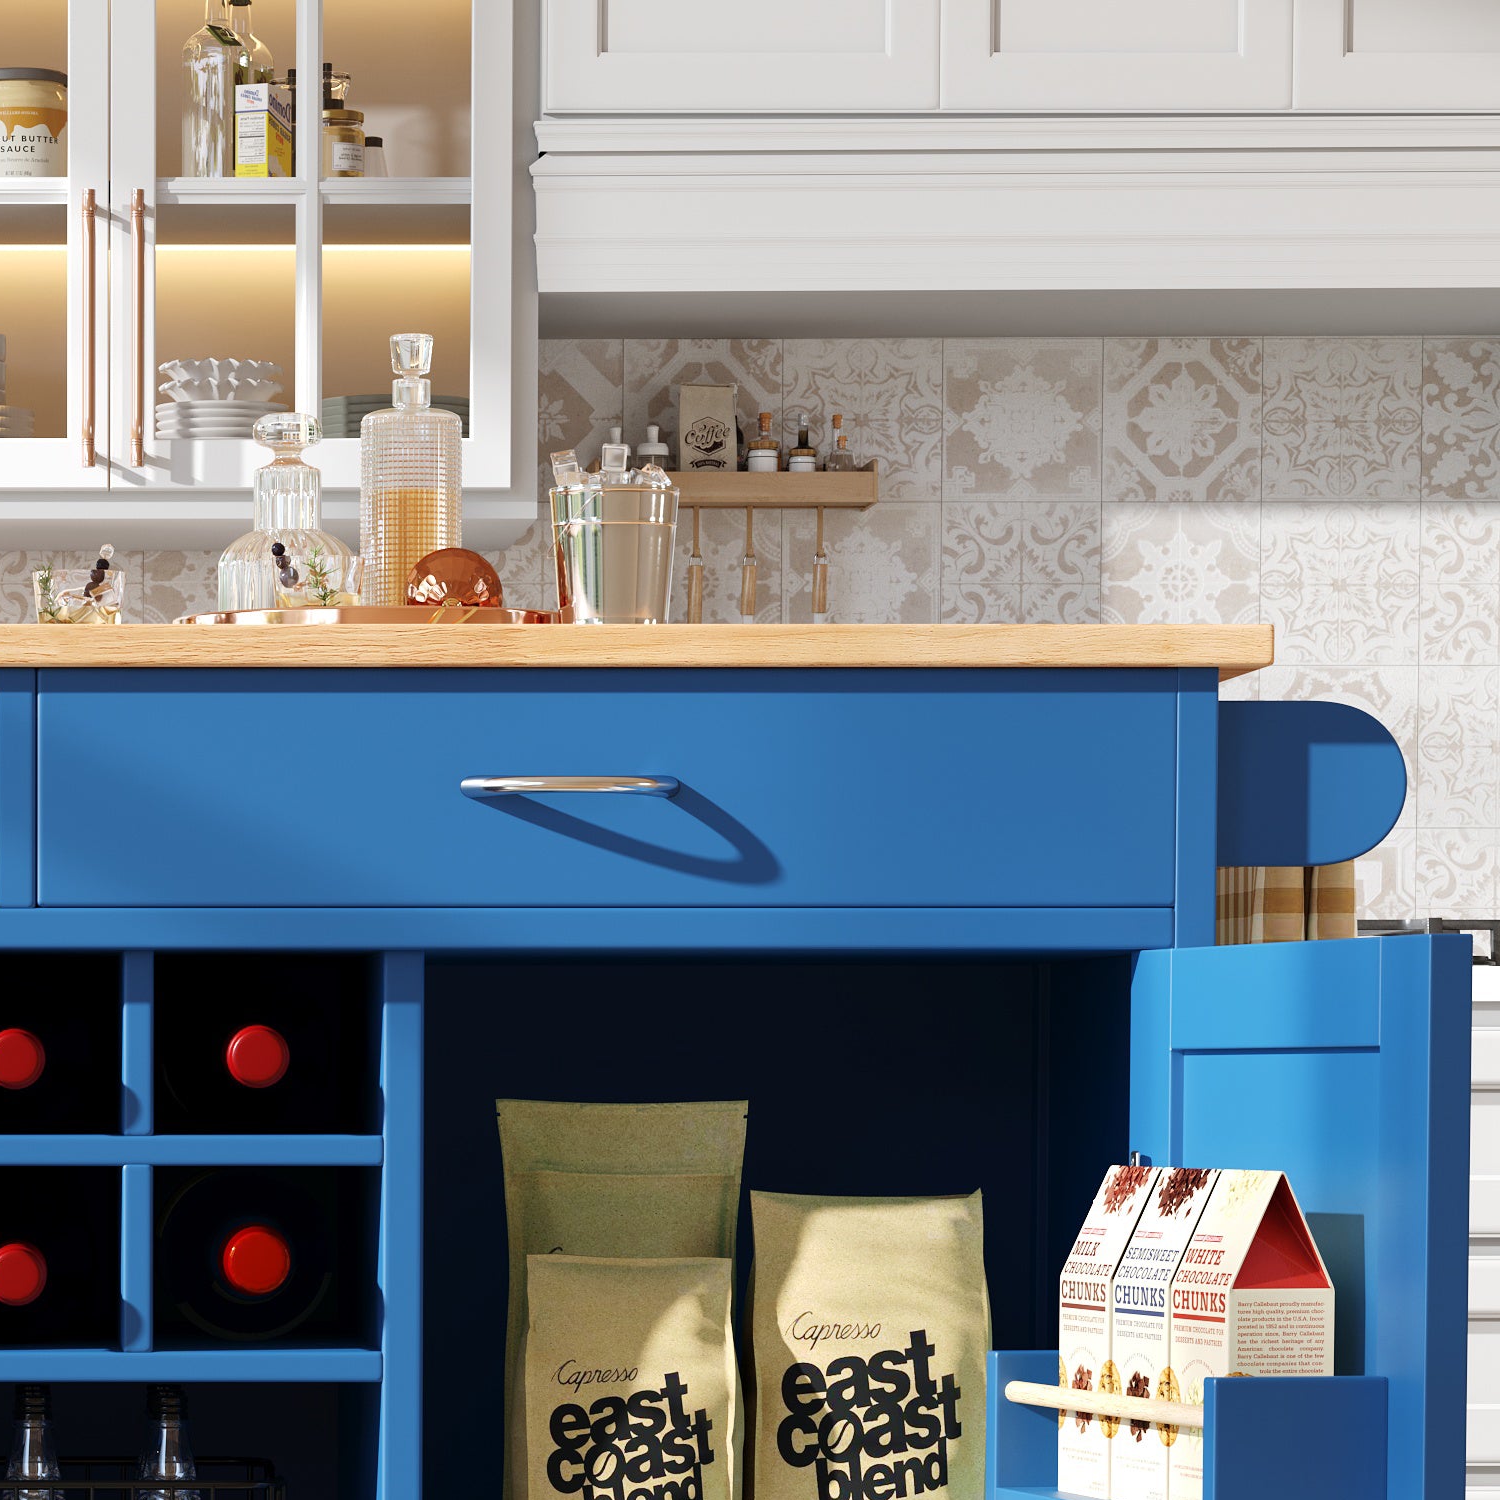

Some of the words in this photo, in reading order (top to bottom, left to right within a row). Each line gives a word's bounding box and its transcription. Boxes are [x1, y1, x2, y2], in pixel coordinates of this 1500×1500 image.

[21, 135, 59, 145] BUTTER
[684, 424, 731, 446] Coffee
[1072, 1240, 1101, 1256] MILK
[1125, 1247, 1179, 1262] SEMISWEET
[1185, 1248, 1226, 1265] WHITE
[1064, 1261, 1112, 1277] CHOCOLATE
[1117, 1265, 1172, 1281] CHOCOLATE
[1176, 1269, 1232, 1286] CHOCOLATE
[1061, 1280, 1106, 1302] CHUNKS
[1115, 1284, 1165, 1307] CHUNKS
[1173, 1289, 1226, 1313] CHUNKS
[784, 1311, 881, 1350] Capresso
[551, 1359, 638, 1393] Capresso
[781, 1329, 937, 1416] east
[550, 1372, 690, 1450] east
[777, 1373, 961, 1467] coast
[547, 1408, 714, 1494] coast
